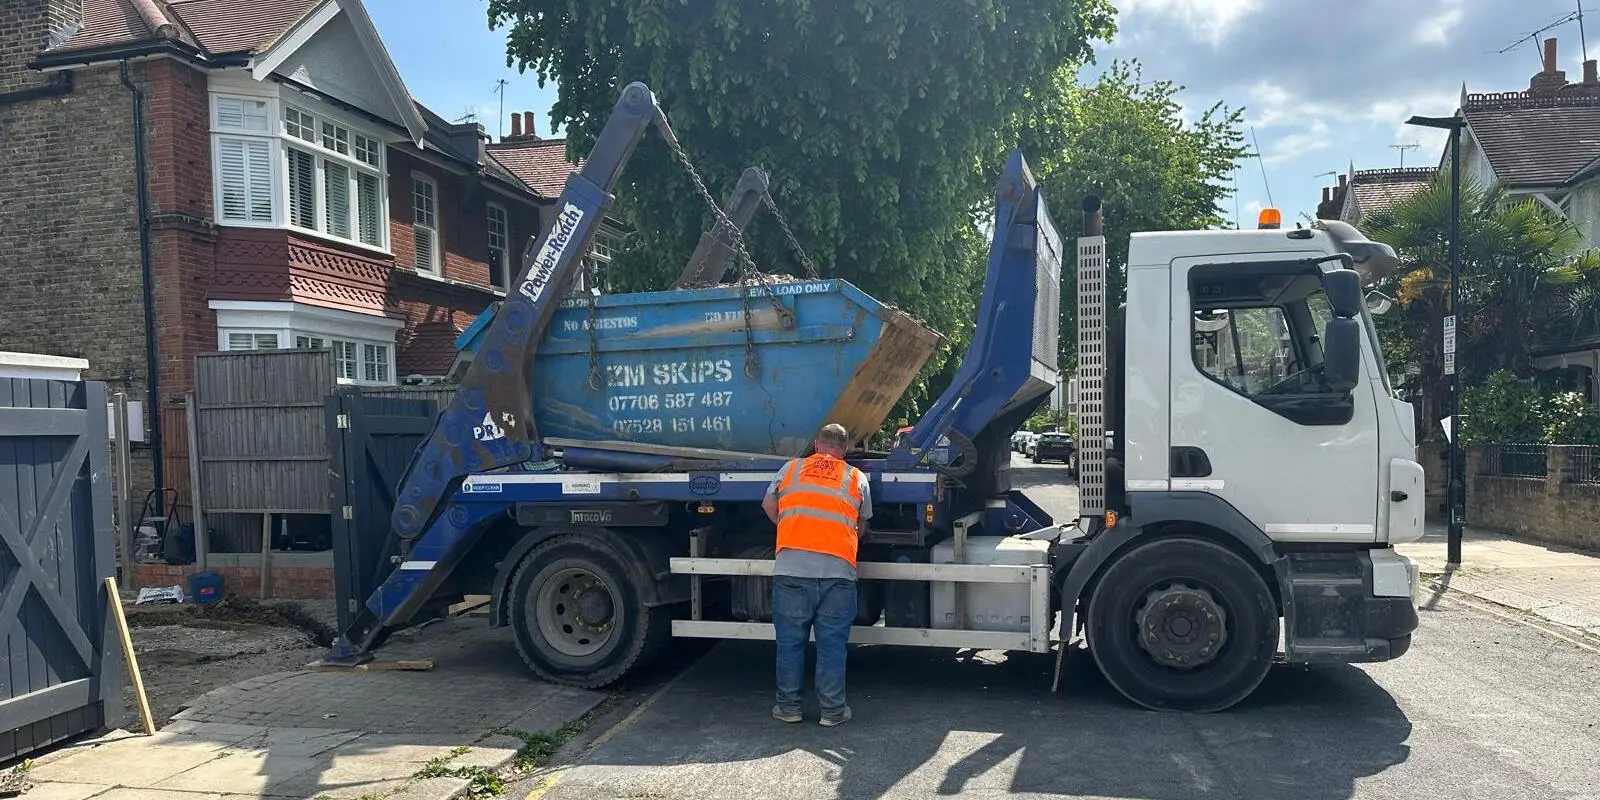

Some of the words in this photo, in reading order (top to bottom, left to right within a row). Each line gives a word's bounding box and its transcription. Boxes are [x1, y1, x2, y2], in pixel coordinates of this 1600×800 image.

[776, 285, 802, 295] LOAD
[805, 283, 831, 293] ONLY
[564, 320, 579, 331] NO
[581, 316, 638, 330] ABESTOS
[653, 360, 733, 385] SKIPS
[608, 394, 660, 411] 07706
[664, 393, 695, 409] 587
[701, 391, 733, 407] 487
[613, 418, 663, 433] 07528
[671, 417, 695, 432] 151
[701, 416, 731, 432] 461
